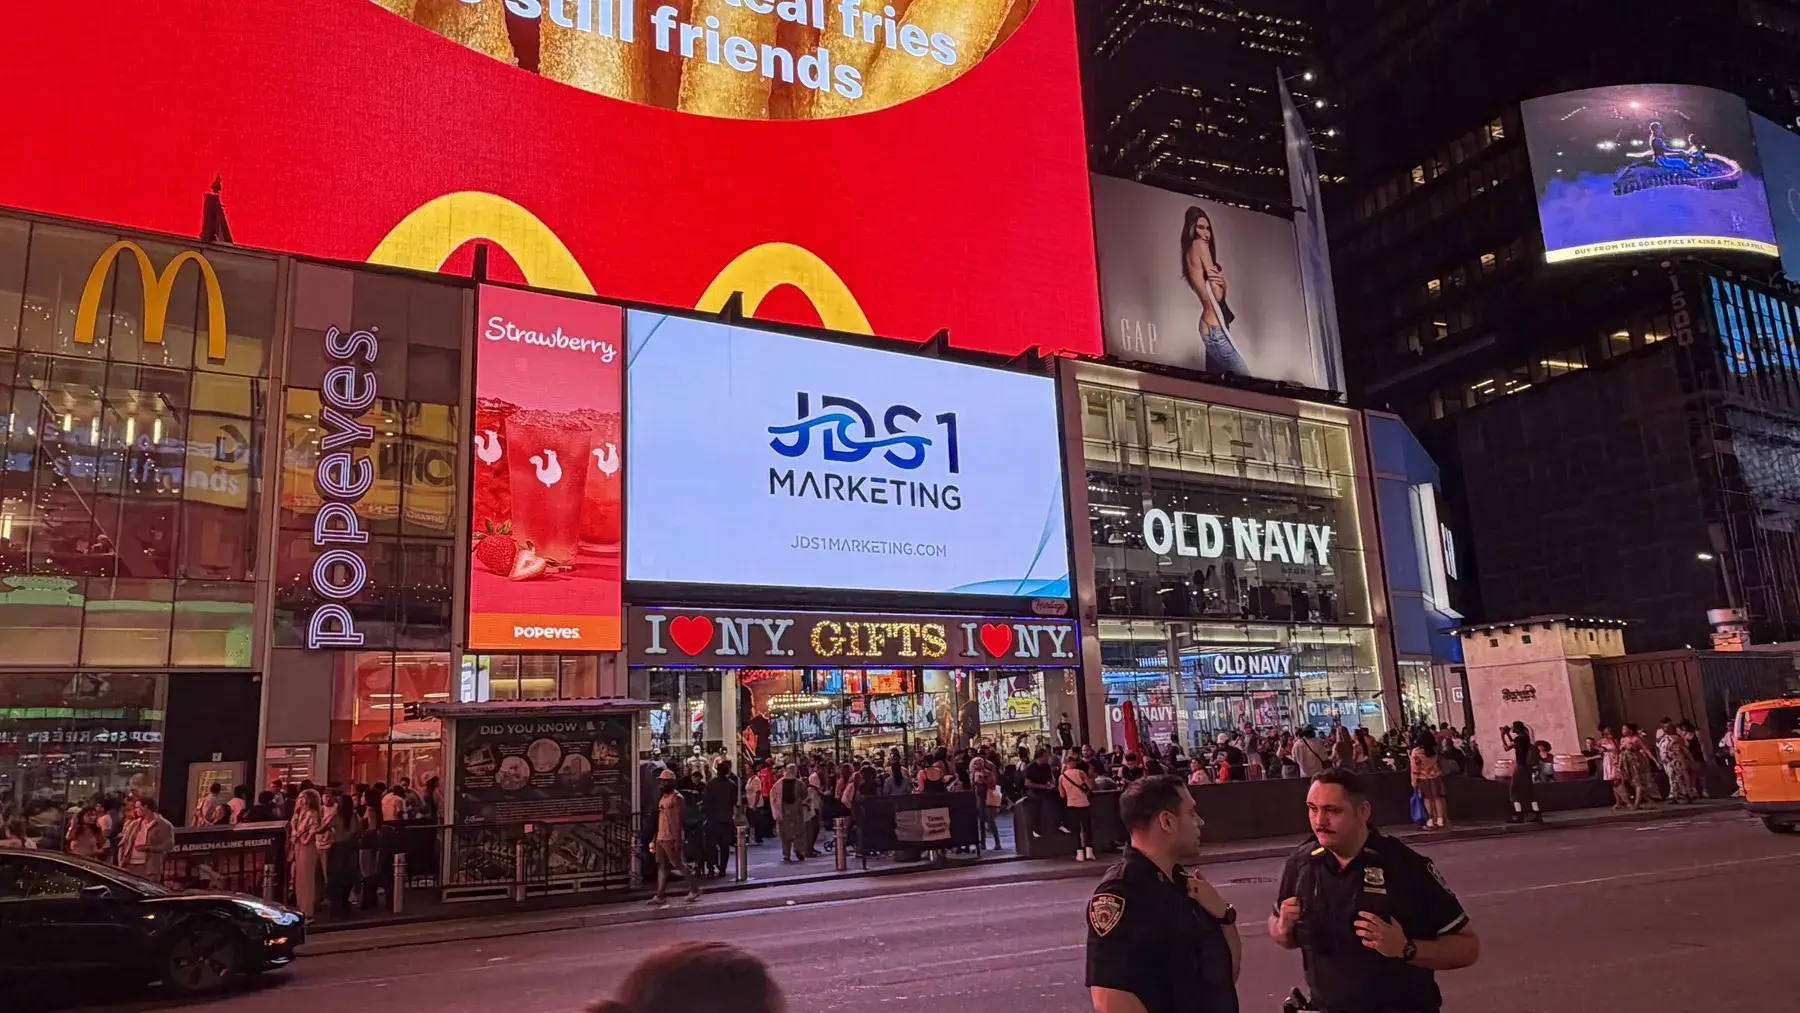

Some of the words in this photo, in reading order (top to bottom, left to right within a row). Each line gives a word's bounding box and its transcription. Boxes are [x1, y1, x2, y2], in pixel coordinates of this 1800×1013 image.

[651, 6, 863, 99] friends
[838, 0, 957, 66] fries
[1593, 244, 1619, 252] FROM
[485, 316, 617, 363] Strawberry
[1120, 318, 1157, 355] GAP
[769, 467, 962, 511] MARKETING
[790, 535, 948, 558] JDS1MARKETING.COM
[1143, 508, 1225, 559] OLD
[1231, 516, 1331, 566] NAVY
[644, 614, 668, 655] I
[809, 618, 948, 659] GIFTS
[959, 621, 981, 657] I
[1214, 655, 1247, 675] OLD
[1248, 655, 1292, 675] NAVY
[480, 725, 505, 735] DID
[507, 723, 534, 734] YOU
[537, 722, 578, 733] KNOW
[182, 840, 244, 852] ADRENALINE
[244, 838, 272, 847] RUSH
